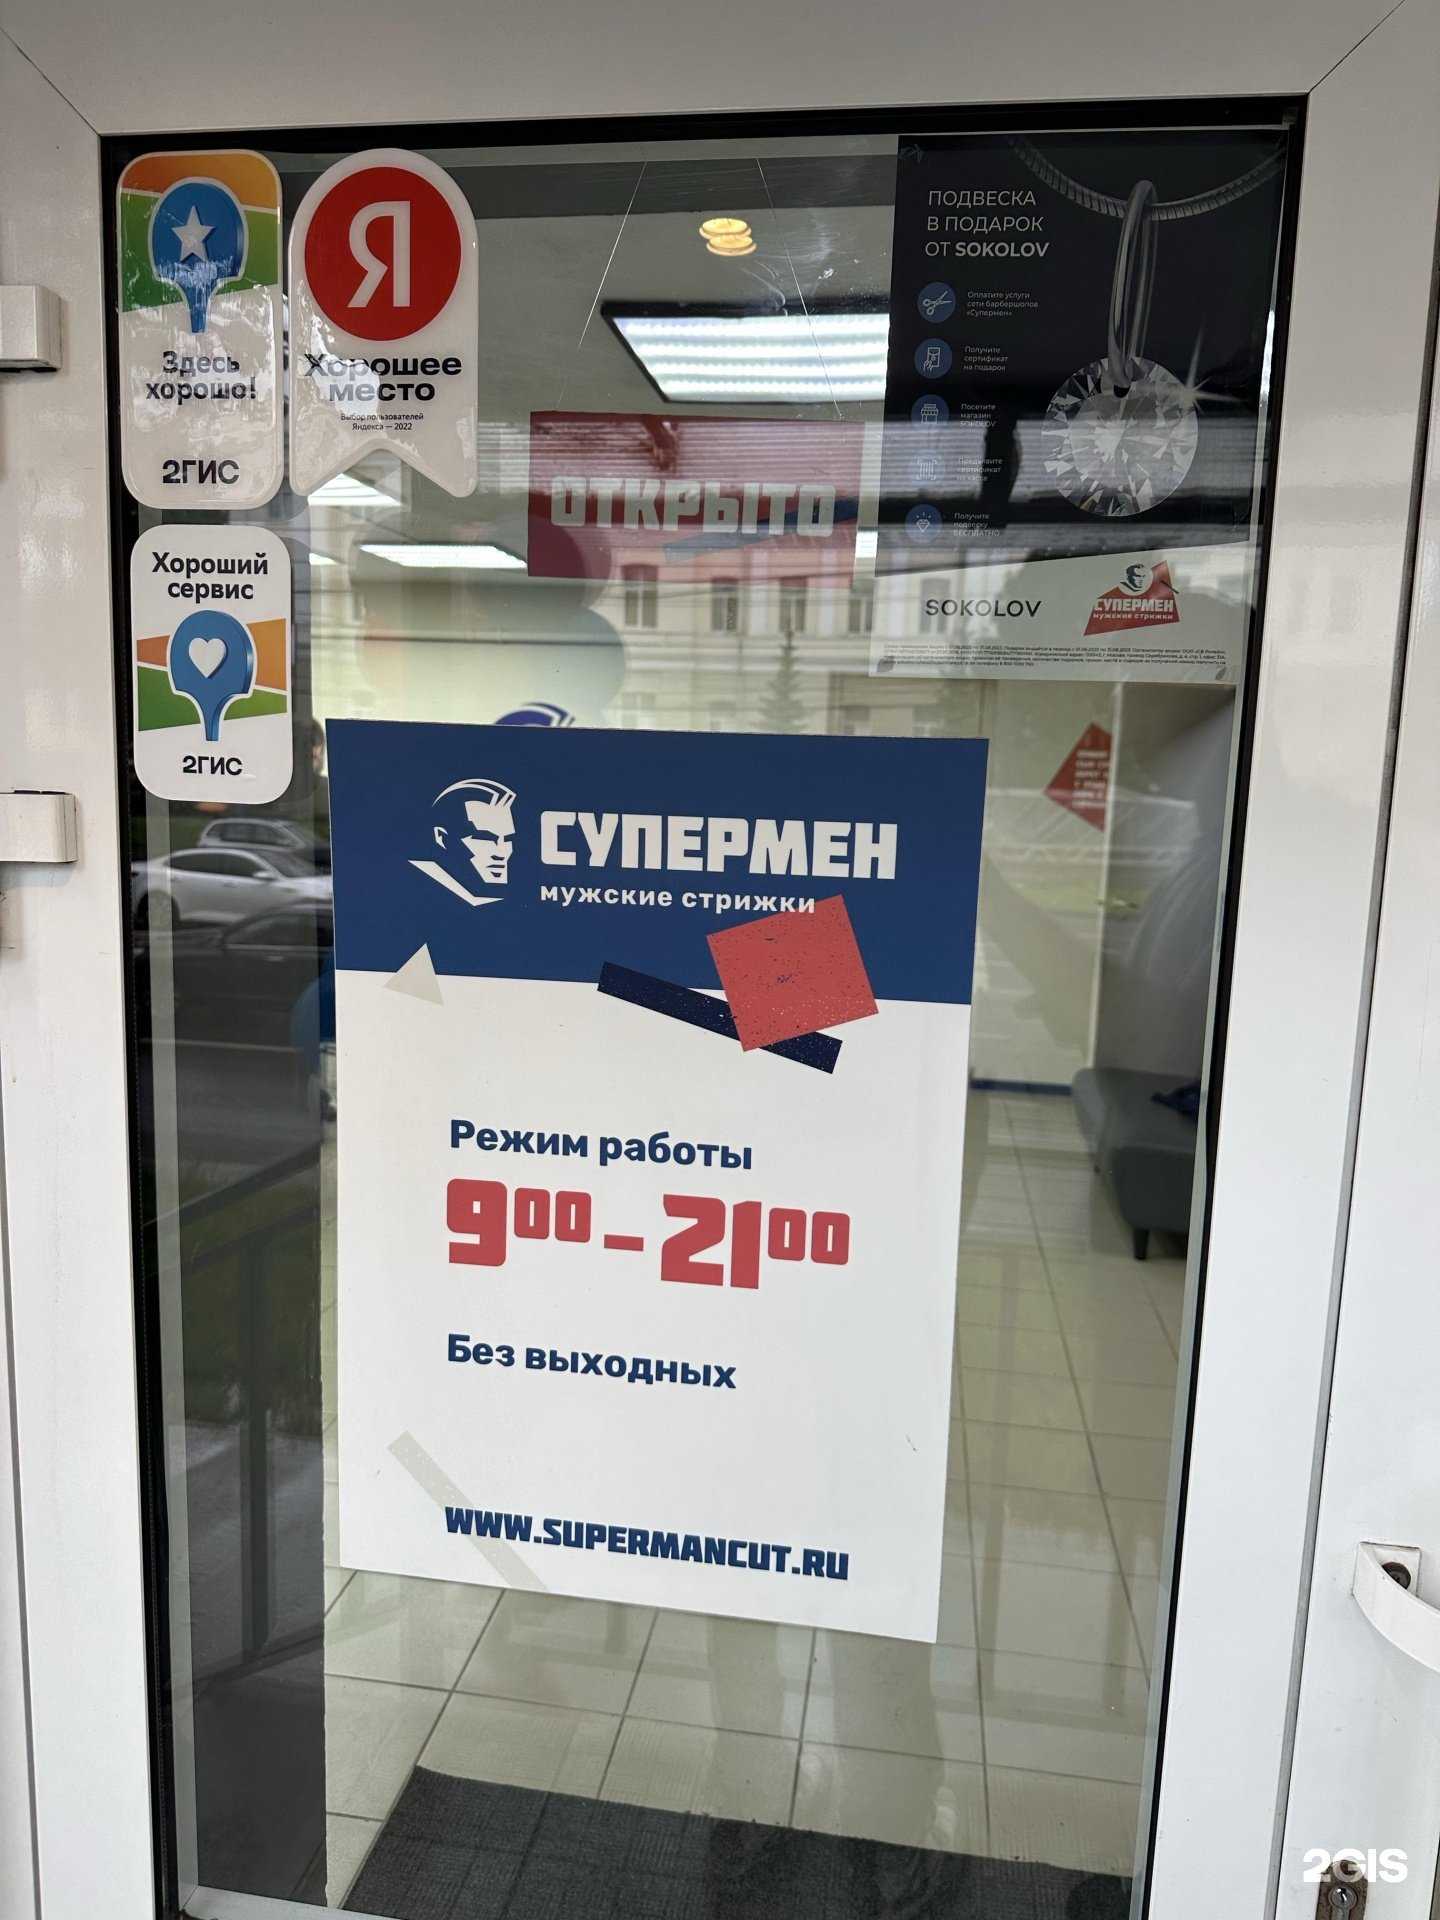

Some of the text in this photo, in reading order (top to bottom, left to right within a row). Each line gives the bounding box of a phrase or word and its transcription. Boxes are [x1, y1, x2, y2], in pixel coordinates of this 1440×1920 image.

[928, 190, 1037, 208] ПОДВЕСКА
[927, 217, 1044, 234] В ПОДАРОК
[348, 201, 410, 307] Я
[925, 242, 1050, 258] ОТ SOKOLOV
[162, 351, 240, 376] Здесь
[304, 354, 462, 382] Хорошее
[146, 377, 256, 405] хорошо!
[329, 382, 436, 401] место
[352, 422, 384, 431] Яндекса
[394, 422, 413, 431] 2022
[162, 460, 240, 484] 2ГИС
[551, 476, 836, 537] ОТКРЫТО
[151, 551, 268, 579] Хороший
[167, 582, 254, 604] сервис
[1095, 599, 1174, 612] СУПЕРМЕН
[925, 599, 1042, 617] SOKOLOV
[182, 755, 243, 776] 2ГИС
[539, 810, 898, 879] СУПЕРМЕН
[540, 883, 816, 915] мужские стрижки
[450, 1119, 753, 1169] Режим работы
[447, 1333, 737, 1389] Без выходных
[445, 1506, 850, 1581] WWW.SUPERMANCUT.RU
